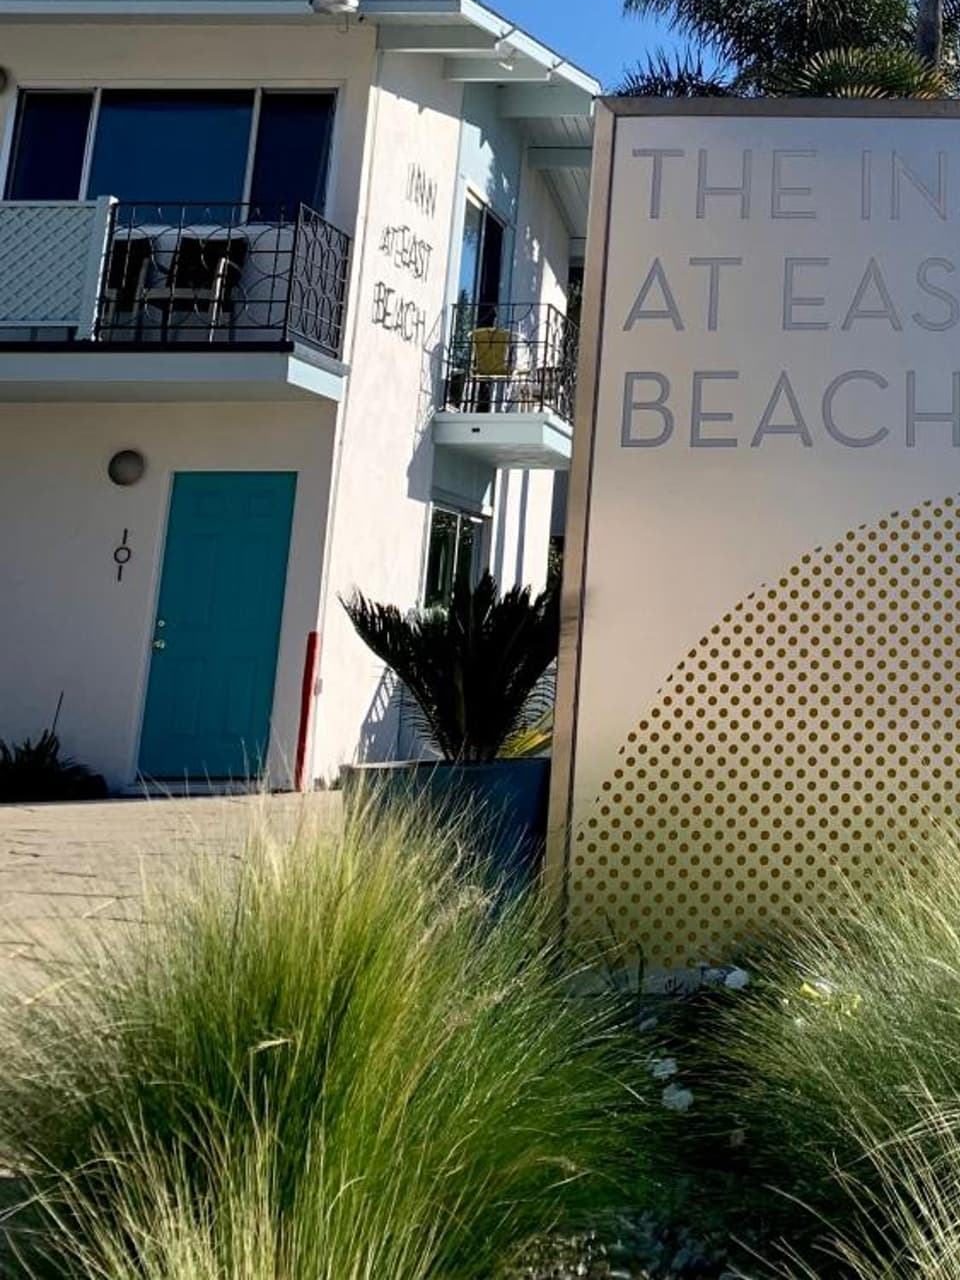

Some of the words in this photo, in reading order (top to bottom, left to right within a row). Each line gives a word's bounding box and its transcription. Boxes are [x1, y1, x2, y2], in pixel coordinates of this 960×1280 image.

[406, 162, 438, 219] INN
[631, 148, 818, 220] THE
[372, 281, 427, 346] BEACH
[622, 256, 744, 332] AT
